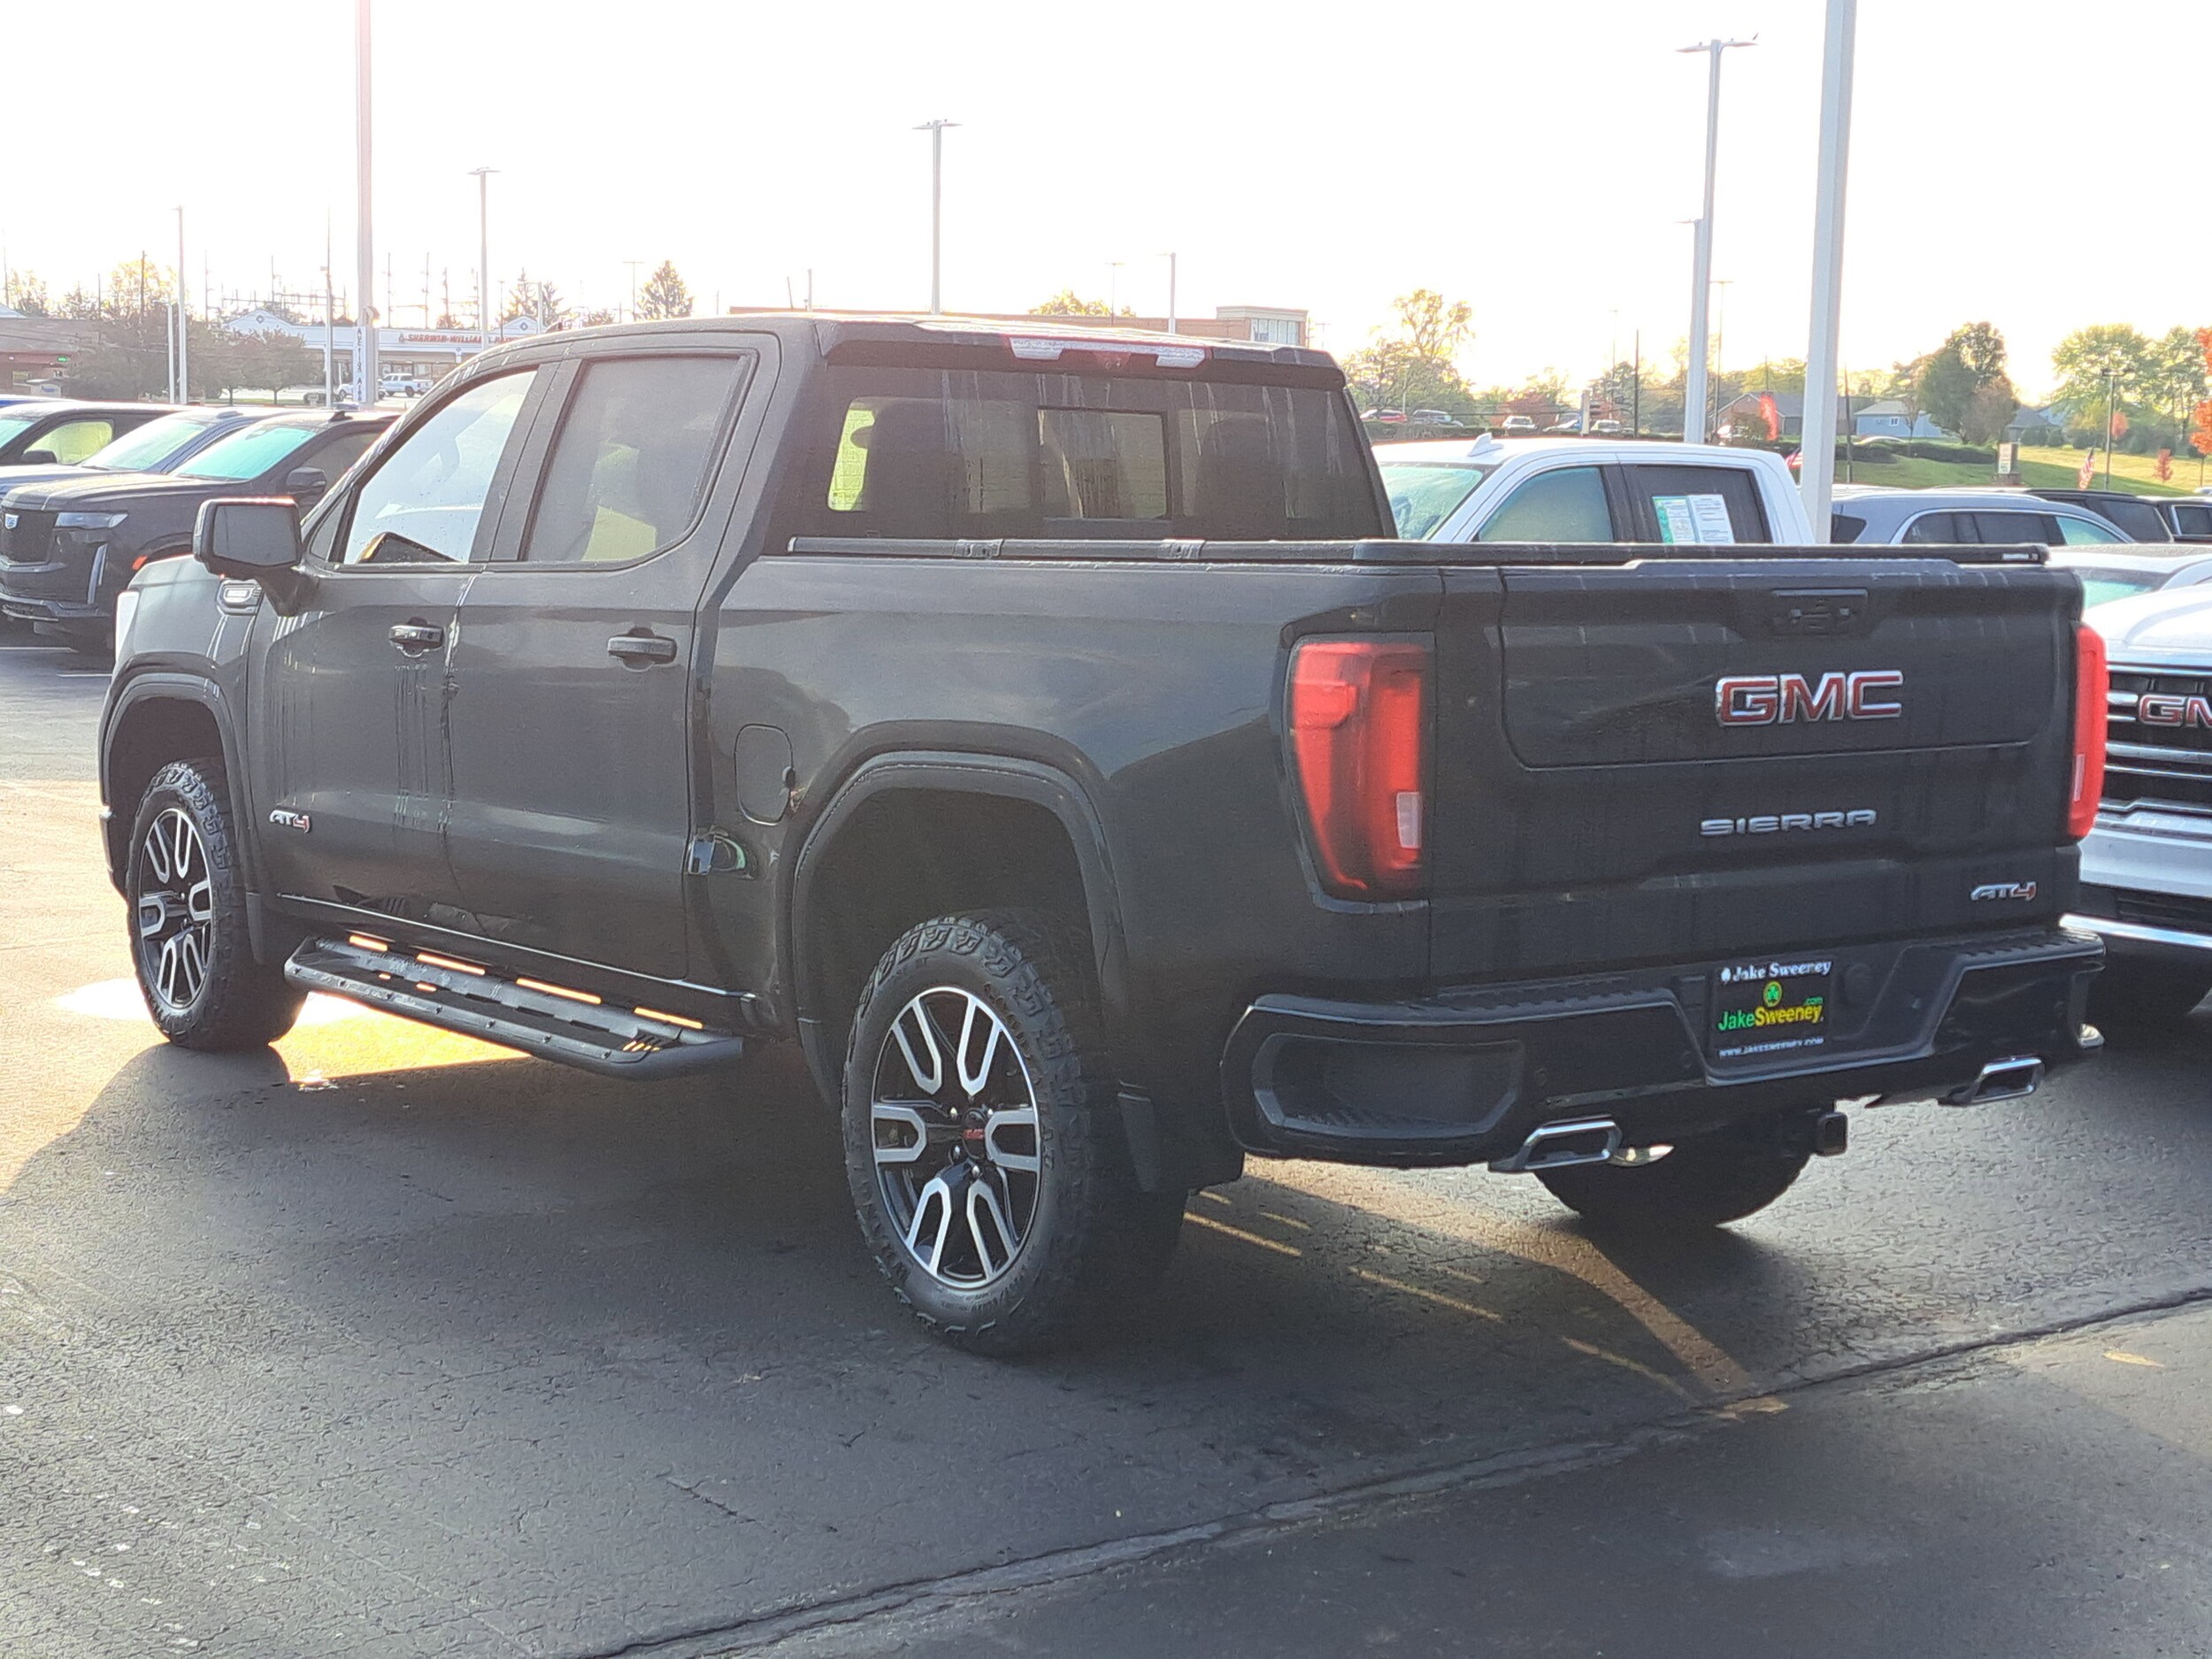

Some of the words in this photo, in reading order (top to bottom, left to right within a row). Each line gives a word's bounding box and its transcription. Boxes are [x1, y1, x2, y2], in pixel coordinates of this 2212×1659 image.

[407, 334, 482, 343] SHERWIN-WILLIA
[1716, 670, 1903, 727] GMC
[269, 809, 310, 834] AT4
[1700, 809, 1877, 836] SIERRA
[1970, 881, 2037, 902] AT4
[1732, 965, 1766, 982] Jake
[1769, 961, 1832, 977] Sweeney
